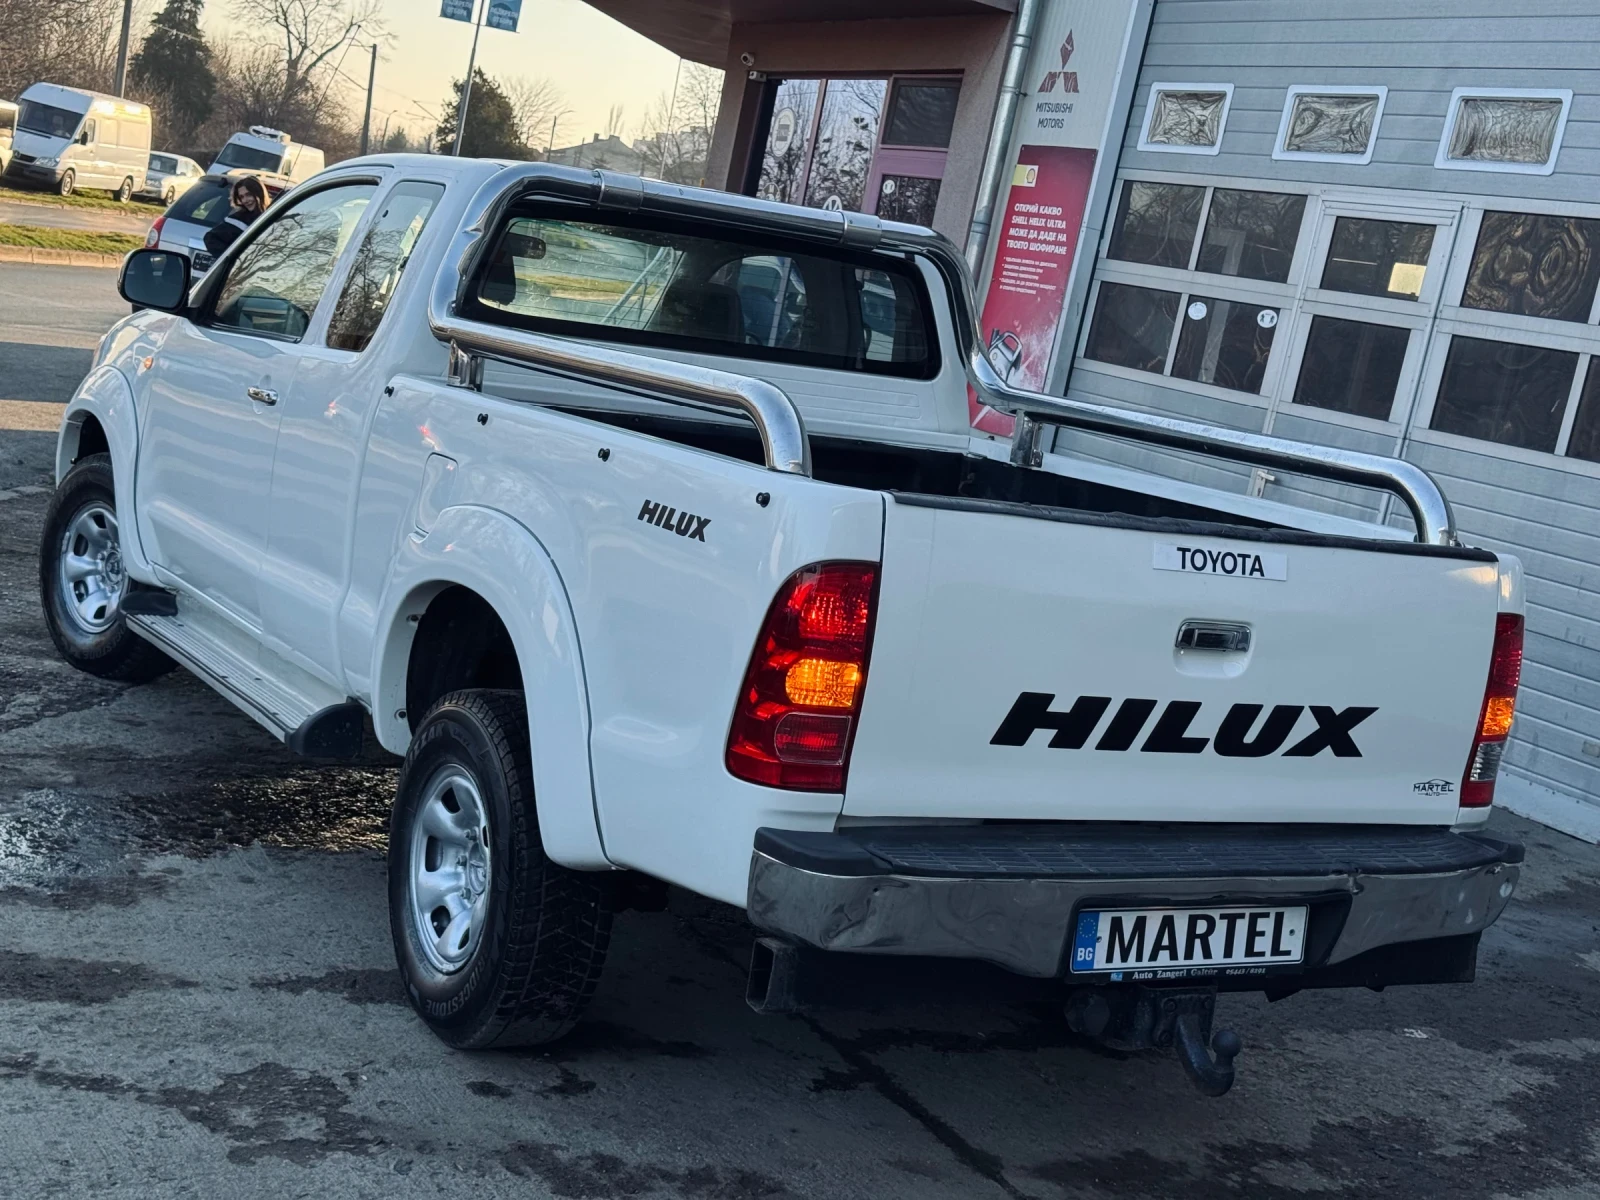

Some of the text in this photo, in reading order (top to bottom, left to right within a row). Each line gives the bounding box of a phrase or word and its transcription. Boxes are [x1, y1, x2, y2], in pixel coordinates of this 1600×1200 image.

[1036, 103, 1073, 113] MITSUBISHI
[1037, 118, 1064, 128] MOTORS
[1014, 203, 1062, 216] ОТКРИЙ КАКВО
[1011, 215, 1066, 229] SHELL HELIX ULTRA
[1008, 228, 1067, 242] МОЖЕ ДА ДАДЕ НА
[1029, 243, 1067, 255] ШОФИРАНЕ
[637, 499, 712, 542] HILUX
[1176, 547, 1265, 577] TOYOTA
[989, 691, 1380, 757] HILUX
[1413, 783, 1454, 792] MARTEL
[1077, 911, 1292, 964] BG MARTEL
[1132, 971, 1153, 980] Auto
[1156, 969, 1187, 979] Zangerl
